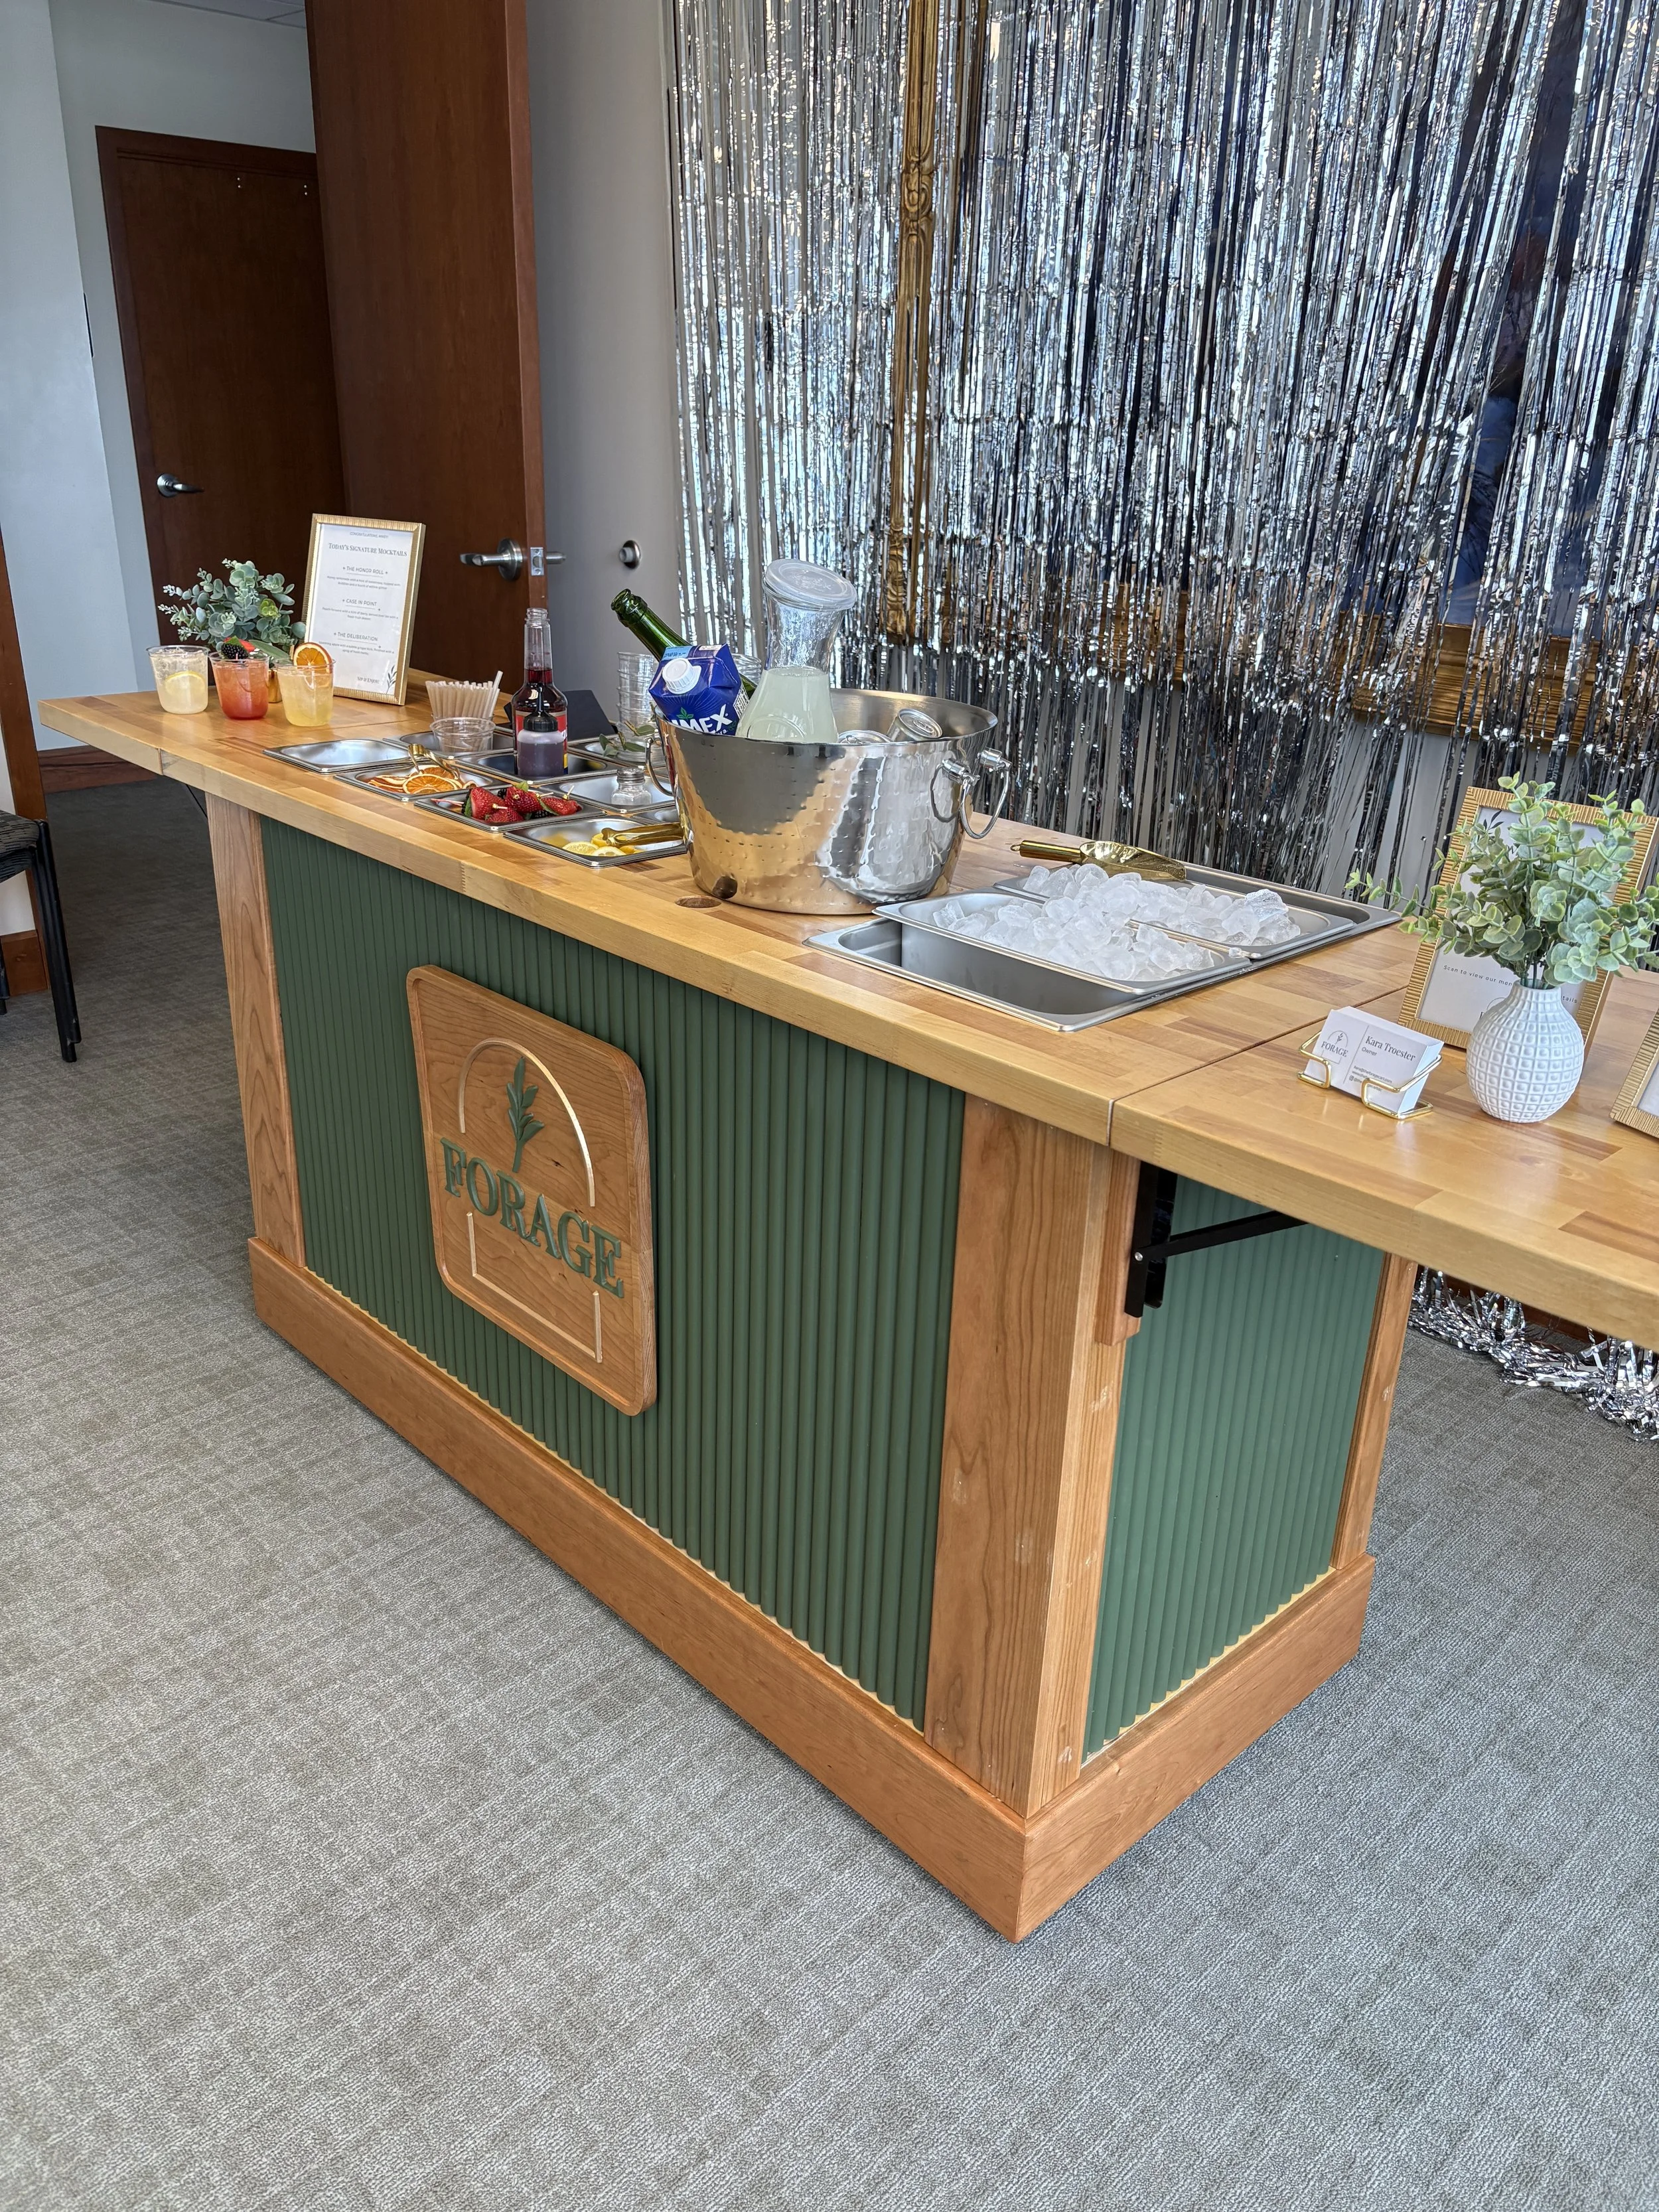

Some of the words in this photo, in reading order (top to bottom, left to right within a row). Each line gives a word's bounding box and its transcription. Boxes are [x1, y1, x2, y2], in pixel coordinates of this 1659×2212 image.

[350, 545, 378, 553] SIGNATURE
[671, 703, 733, 734] MEX
[1321, 1041, 1348, 1057] FORAGE
[1361, 1047, 1377, 1057] Owner
[1365, 1035, 1383, 1049] Kara
[1384, 1042, 1416, 1061] Troester
[439, 1137, 624, 1299] FORAGE
